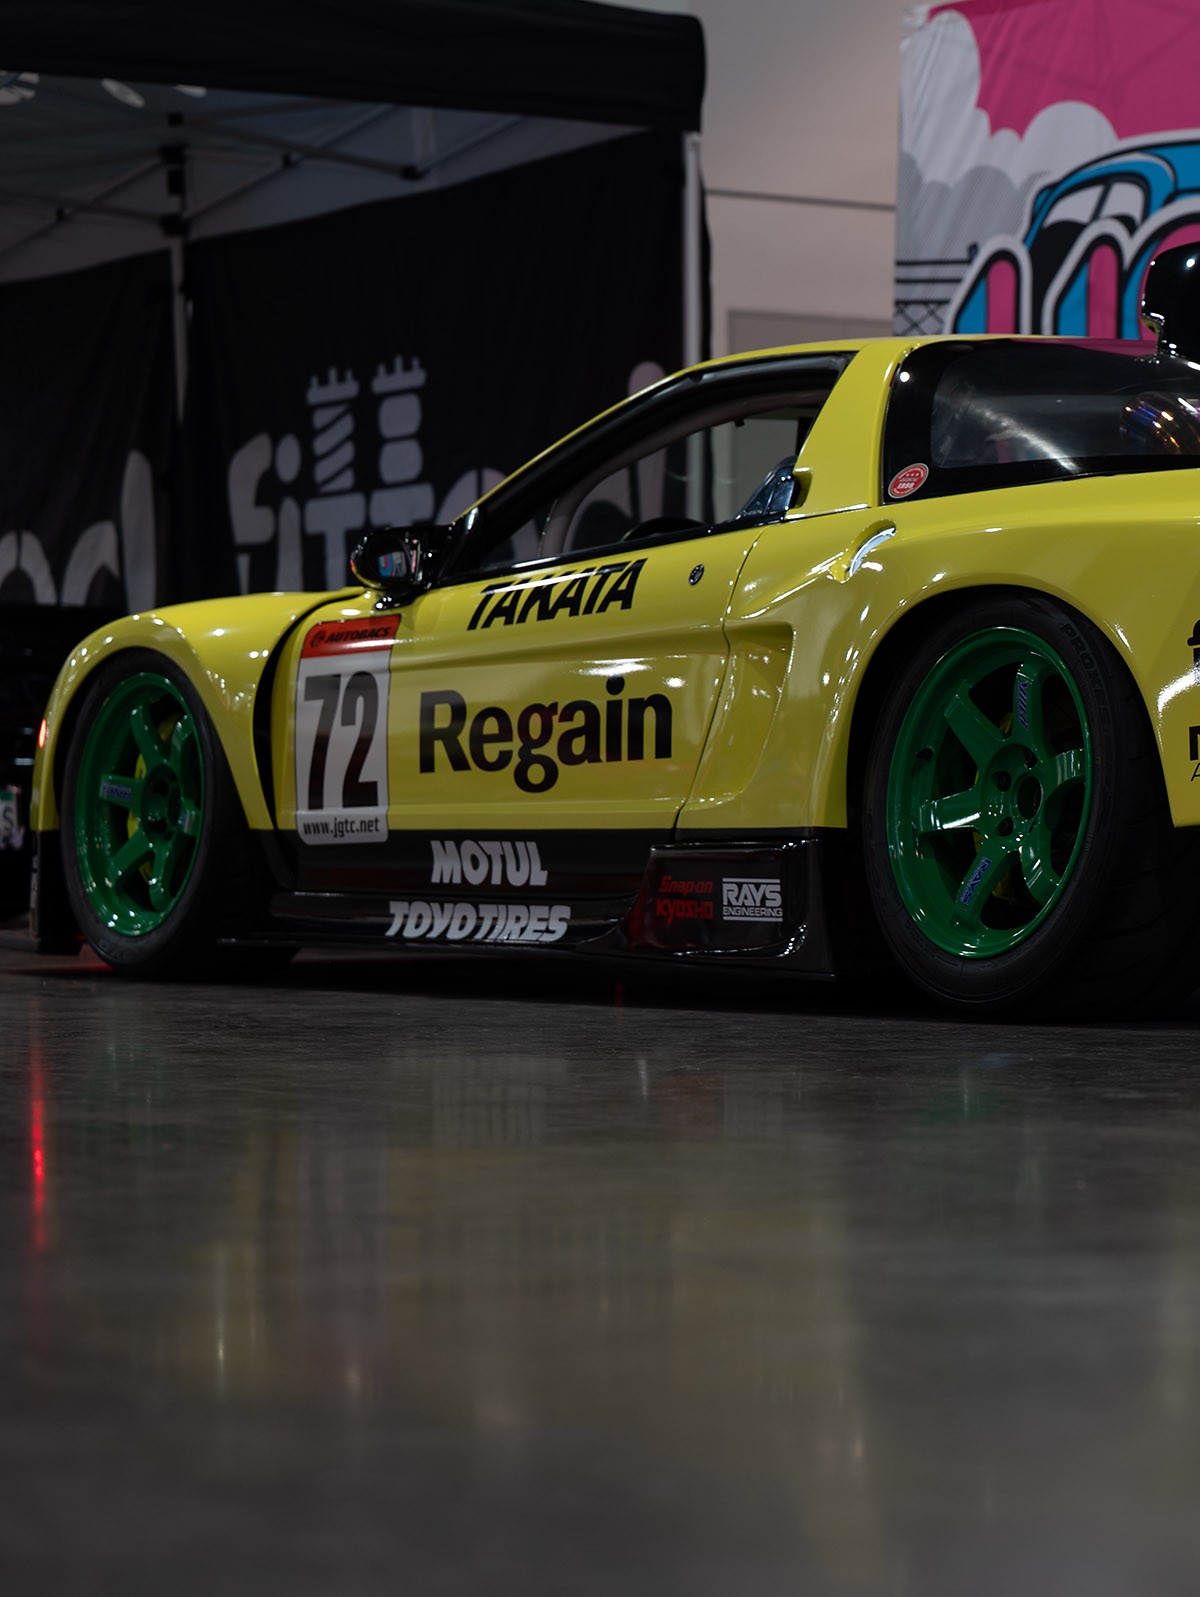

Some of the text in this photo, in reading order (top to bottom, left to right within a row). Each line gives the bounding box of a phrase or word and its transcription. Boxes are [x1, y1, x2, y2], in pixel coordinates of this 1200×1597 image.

[467, 558, 648, 631] TAKATA
[325, 626, 392, 643] AUTOBACS
[303, 671, 379, 810] 72
[419, 676, 672, 792] Regain
[303, 817, 380, 838] www.jgtc.net
[430, 839, 549, 887] MOTUL
[722, 882, 783, 907] RAYS
[722, 907, 783, 917] ENGINEERING
